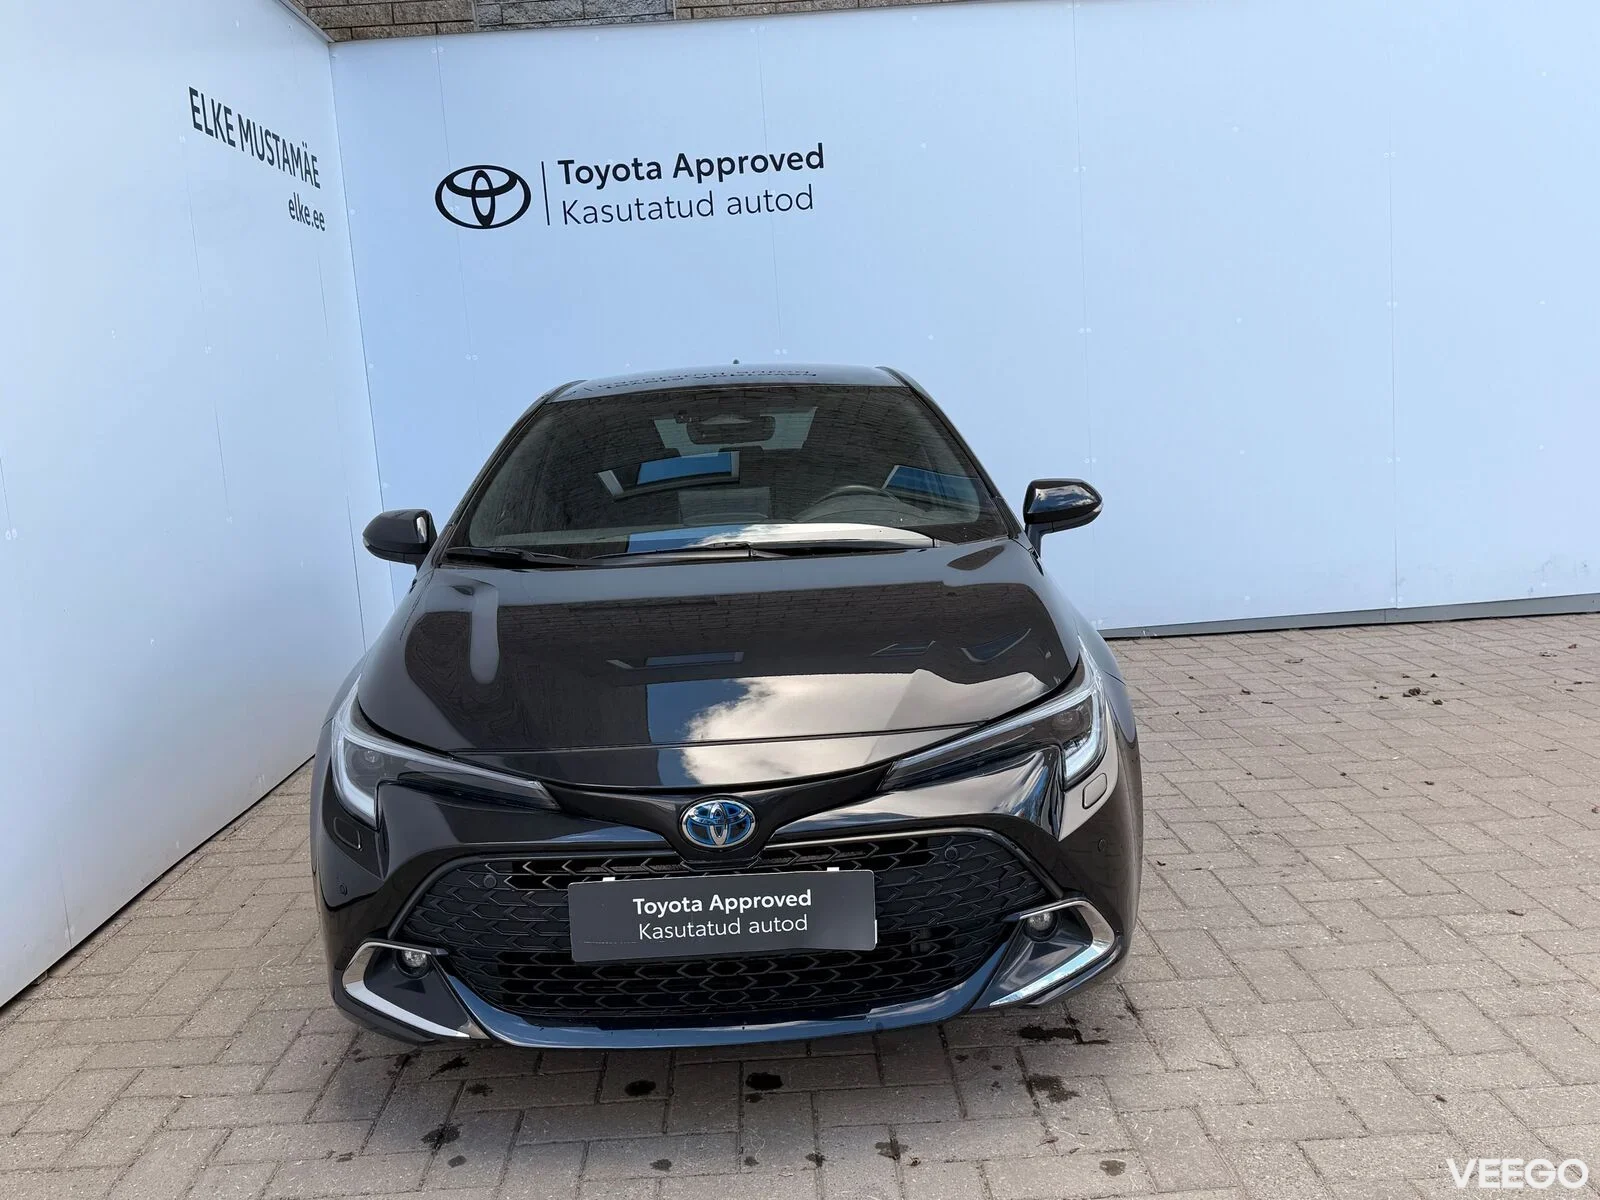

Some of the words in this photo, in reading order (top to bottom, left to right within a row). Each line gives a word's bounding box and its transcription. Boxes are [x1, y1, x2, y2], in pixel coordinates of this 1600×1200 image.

[188, 86, 236, 148] ELKE
[237, 113, 321, 190] MUSTAMÄE
[557, 157, 662, 191] Toyota
[672, 142, 825, 184] Approved
[288, 191, 326, 232] elke.ee
[562, 189, 714, 226] Kasutatud
[727, 183, 814, 216] autod
[632, 896, 703, 919] Toyota
[708, 888, 812, 915] Approved
[638, 917, 741, 940] Kasutatud
[748, 913, 808, 934] autod
